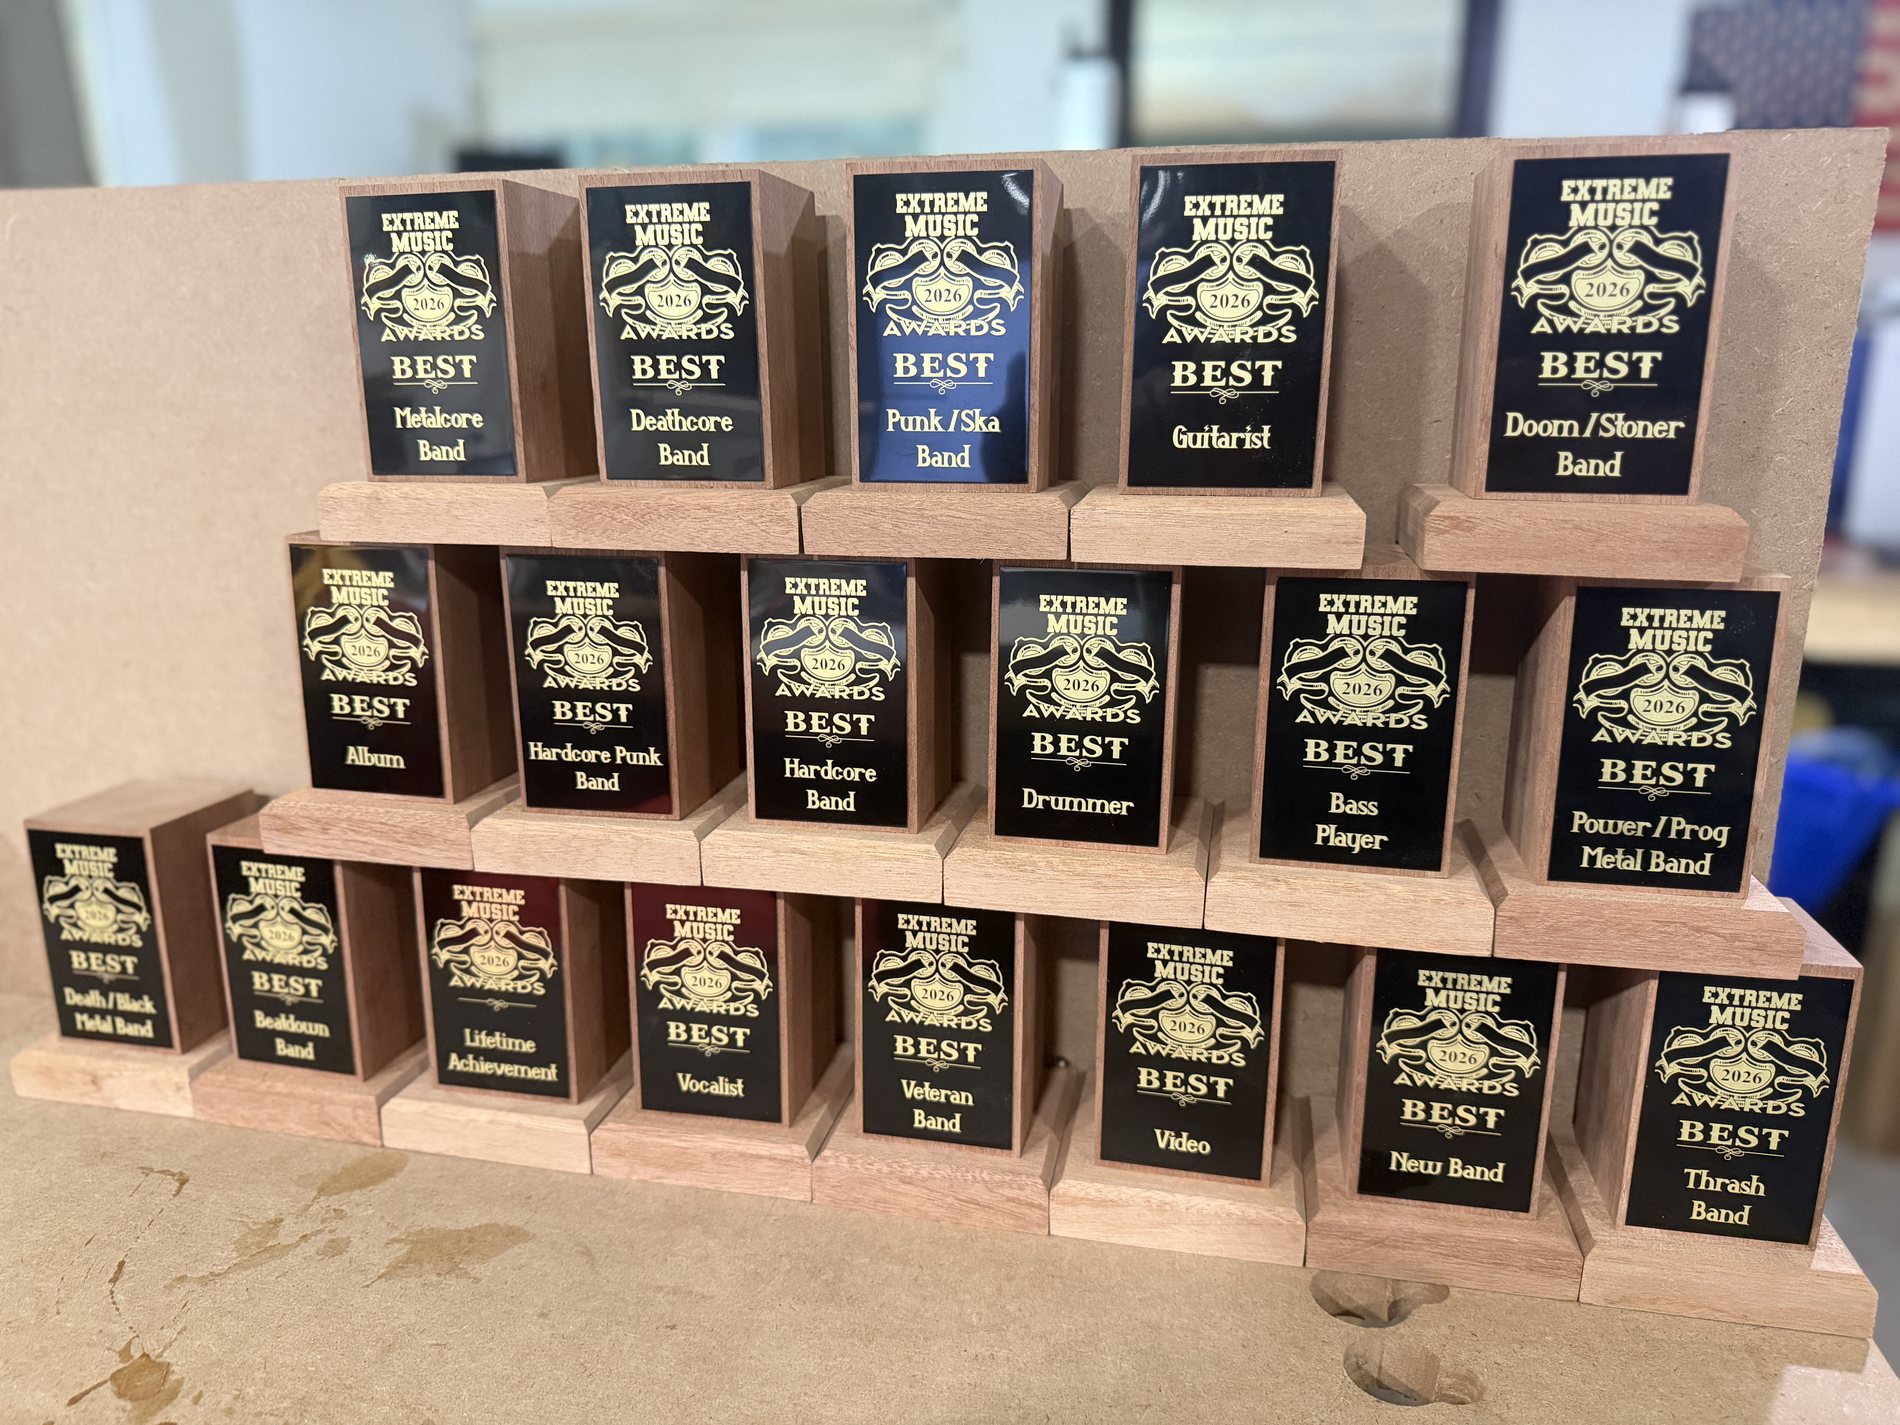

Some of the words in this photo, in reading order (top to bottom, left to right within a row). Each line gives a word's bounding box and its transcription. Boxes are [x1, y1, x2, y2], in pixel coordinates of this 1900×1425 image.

[1561, 177, 1673, 202] EXTREME
[625, 202, 710, 224] EXTREME
[896, 192, 988, 214] EXTREME
[1184, 194, 1284, 216] EXTREME
[381, 211, 459, 231] EXTREME
[1568, 201, 1660, 228] MUSIC
[635, 223, 704, 247] MUSIC
[904, 214, 979, 238] MUSIC
[1192, 217, 1273, 241] MUSIC
[390, 230, 454, 252] MUSIC
[657, 293, 691, 308] 2026
[924, 288, 962, 303] 2026
[1584, 281, 1630, 298] 2026
[413, 297, 445, 311] 2026
[1209, 293, 1250, 309] 2026
[380, 324, 485, 342] AWARDS
[620, 323, 735, 340] AWARDS
[882, 320, 1006, 337] AWARDS
[1162, 326, 1297, 344] AWARDS
[1531, 315, 1680, 334] AWARDS
[390, 355, 477, 379] BEST
[630, 355, 725, 380] BEST
[892, 352, 994, 378] BEST
[1170, 360, 1283, 387] BEST
[1539, 351, 1662, 379] BEST
[394, 407, 484, 429] Metalcore
[630, 408, 734, 431] Deathcore
[1172, 424, 1271, 450] Guitarist
[417, 439, 467, 461] Band
[657, 443, 710, 466] Band
[916, 444, 971, 468] Band
[1555, 451, 1624, 477] Band
[321, 568, 395, 588] EXTREME
[545, 580, 619, 598] EXTREME
[784, 577, 867, 596] EXTREME
[330, 586, 389, 607] MUSIC
[554, 597, 614, 616] MUSIC
[793, 596, 859, 617] MUSIC
[1039, 594, 1128, 615] EXTREME
[1319, 593, 1418, 615] EXTREME
[1047, 614, 1118, 636] MUSIC
[1326, 614, 1407, 637] MUSIC
[1620, 607, 1726, 629] EXTREME
[350, 645, 381, 657] 2026
[1628, 629, 1714, 651] MUSIC
[574, 652, 604, 665] 2026
[811, 657, 845, 671] 2026
[320, 668, 418, 686] AWARDS
[542, 676, 641, 692] AWARDS
[1063, 678, 1099, 692] 2026
[775, 683, 886, 701] AWARDS
[1341, 682, 1383, 696] 2026
[329, 693, 410, 719] BEST
[551, 700, 633, 723] BEST
[1022, 704, 1141, 724] AWARDS
[1642, 699, 1685, 714] 2026
[784, 710, 875, 735] BEST
[1295, 709, 1428, 730] AWARDS
[1030, 732, 1129, 759] BEST
[1591, 727, 1732, 749] AWARDS
[345, 745, 406, 769] Album
[528, 741, 611, 764] Hardcore
[614, 746, 664, 766] Punk
[1302, 738, 1413, 767] BEST
[783, 757, 877, 782] Hardcore
[1599, 758, 1716, 787] BEST
[575, 771, 620, 791] Band
[806, 789, 856, 811] Band
[1021, 787, 1135, 816] Drummer
[1328, 791, 1379, 816] Bass
[1314, 823, 1390, 854] Player
[54, 843, 118, 863] EXTREME
[1579, 846, 1645, 871] Metal
[1647, 850, 1714, 876] Band
[63, 859, 114, 878] MUSIC
[240, 861, 306, 882] EXTREME
[248, 877, 302, 898] MUSIC
[453, 884, 525, 905] EXTREME
[460, 900, 520, 921] MUSIC
[665, 903, 741, 924] EXTREME
[673, 920, 734, 941] MUSIC
[897, 913, 977, 935] EXTREME
[60, 928, 143, 948] AWARDS
[905, 930, 969, 953] MUSIC
[69, 950, 138, 975] BEST
[242, 949, 329, 970] AWARDS
[480, 954, 509, 966] 2026
[1147, 942, 1234, 967] EXTREME
[691, 976, 722, 988] 2026
[1154, 960, 1224, 984] MUSIC
[1417, 969, 1513, 994] EXTREME
[250, 971, 323, 998] BEST
[448, 975, 546, 995] AWARDS
[922, 989, 954, 1001] 2026
[657, 997, 760, 1017] AWARDS
[1424, 988, 1501, 1013] MUSIC
[1702, 986, 1803, 1010] EXTREME
[74, 1011, 114, 1034] Metal
[114, 1016, 154, 1039] Band
[254, 1009, 330, 1038] Beatdown
[885, 1010, 992, 1032] AWARDS
[1169, 1020, 1205, 1034] 2026
[1709, 1006, 1790, 1030] MUSIC
[464, 1028, 537, 1054] Lifetime
[666, 1021, 750, 1047] BEST
[274, 1037, 316, 1060] Band
[893, 1034, 982, 1063] BEST
[1129, 1040, 1247, 1068] AWARDS
[1440, 1050, 1477, 1064] 2026
[447, 1052, 559, 1081] Achievement
[1722, 1069, 1761, 1084] 2026
[676, 1072, 745, 1097] Vocalist
[900, 1079, 975, 1106] Veteran
[1136, 1067, 1233, 1099] BEST
[1393, 1071, 1520, 1097] AWARDS
[1400, 1098, 1506, 1129] BEST
[1671, 1091, 1806, 1117] AWARDS
[913, 1109, 962, 1133] Band
[1153, 1128, 1211, 1155] Video
[1676, 1120, 1790, 1150] BEST
[1388, 1150, 1443, 1175] New
[1447, 1157, 1506, 1183] Band
[1684, 1168, 1766, 1196] Thrash
[1689, 1200, 1752, 1226] Band
